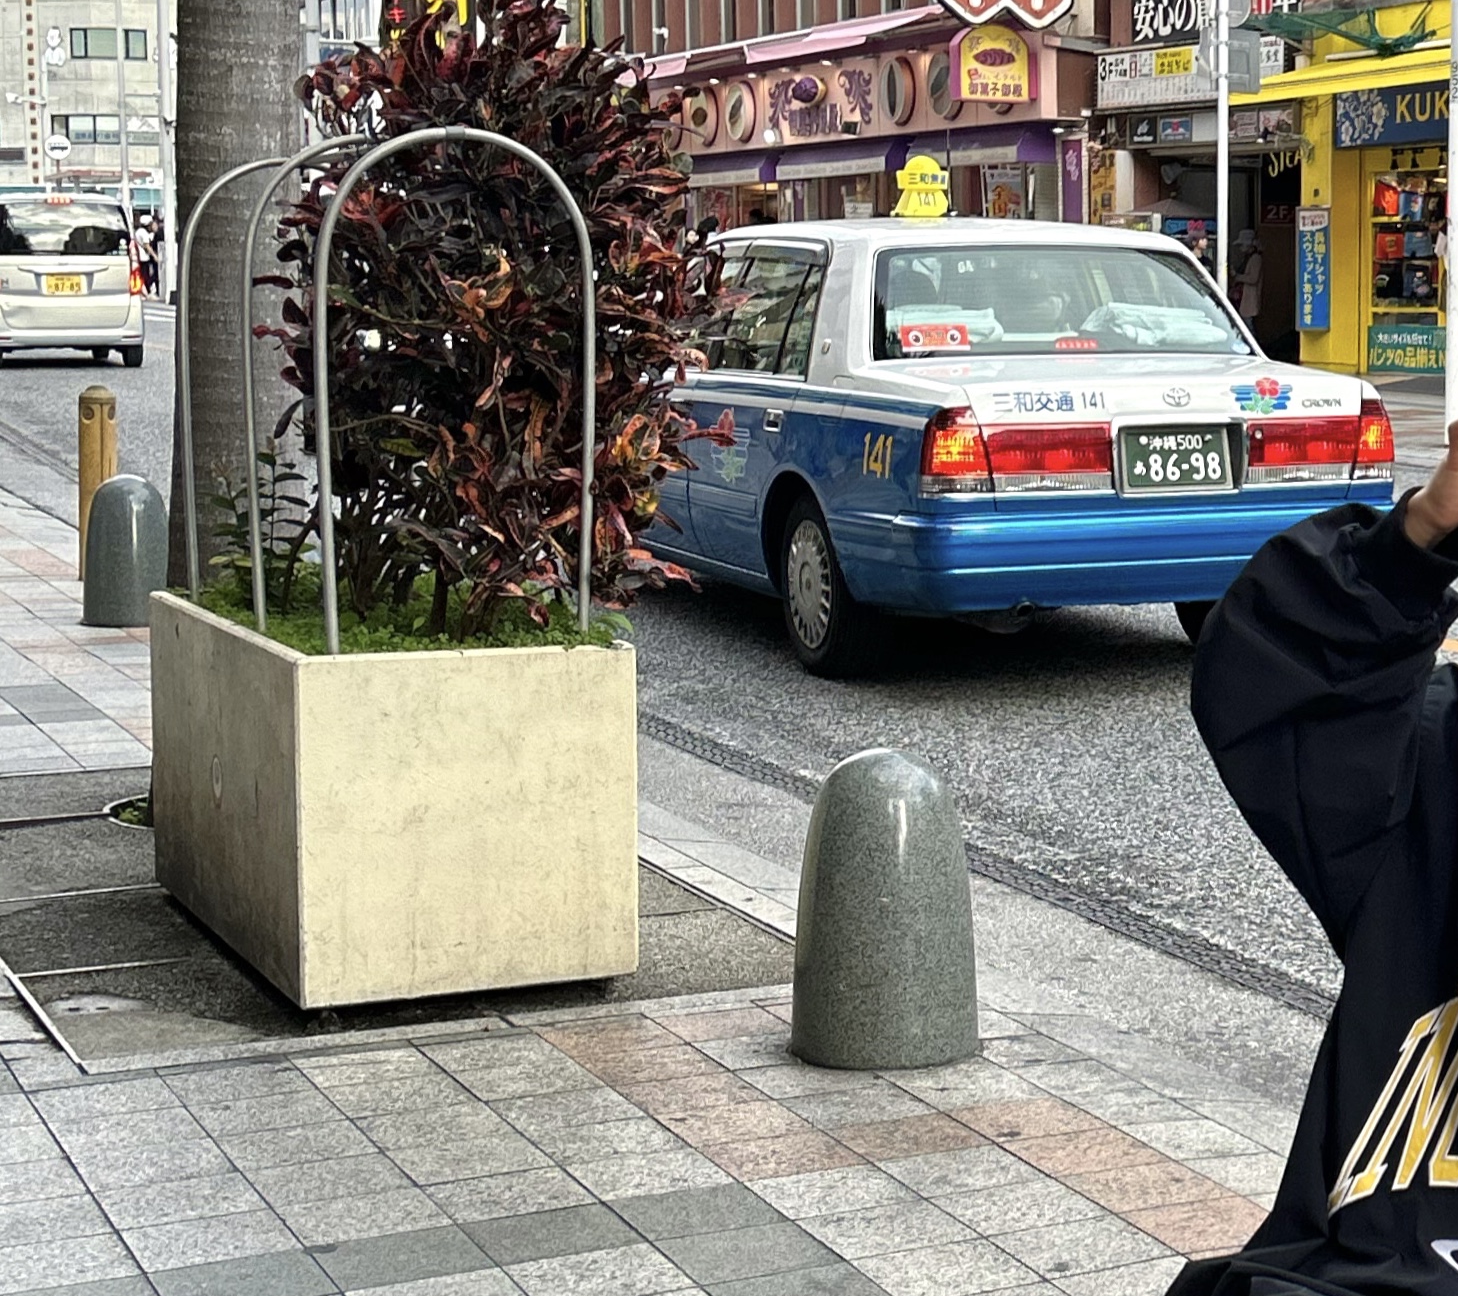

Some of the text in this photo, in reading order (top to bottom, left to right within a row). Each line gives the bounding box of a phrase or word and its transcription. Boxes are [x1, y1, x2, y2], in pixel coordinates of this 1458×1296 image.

[917, 191, 937, 208] 141
[991, 390, 1105, 414] 三和交通 141
[862, 432, 894, 480] 141
[1148, 451, 1223, 483] 86-98
